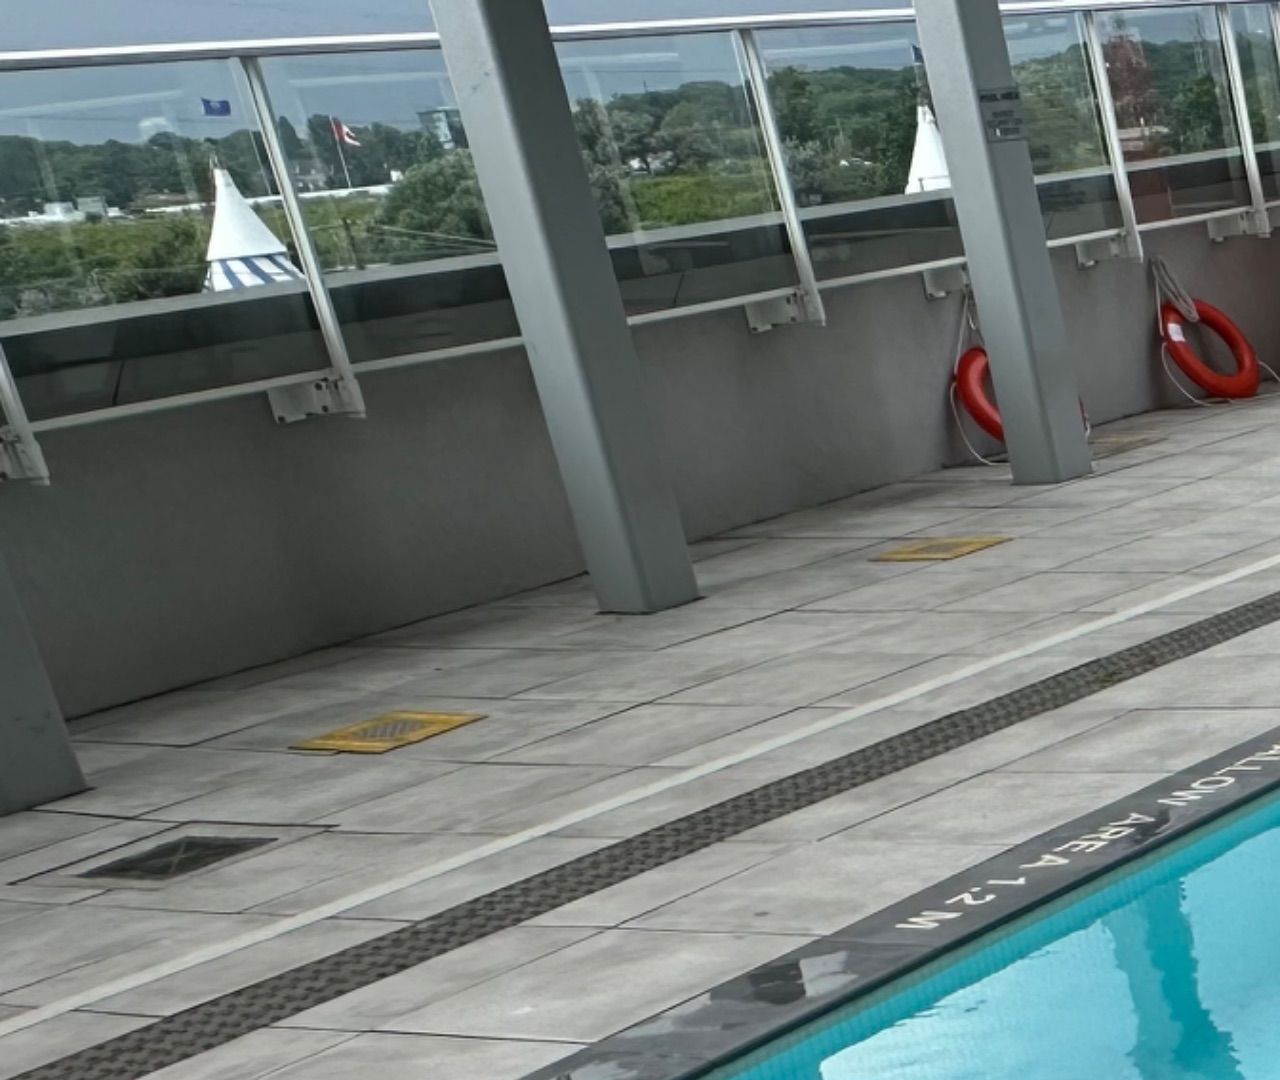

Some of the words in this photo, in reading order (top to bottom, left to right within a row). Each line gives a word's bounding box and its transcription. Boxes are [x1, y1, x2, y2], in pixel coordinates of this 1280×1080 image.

[1018, 812, 1156, 869] AREA
[944, 876, 1027, 906] 1.2
[894, 910, 964, 930] M
